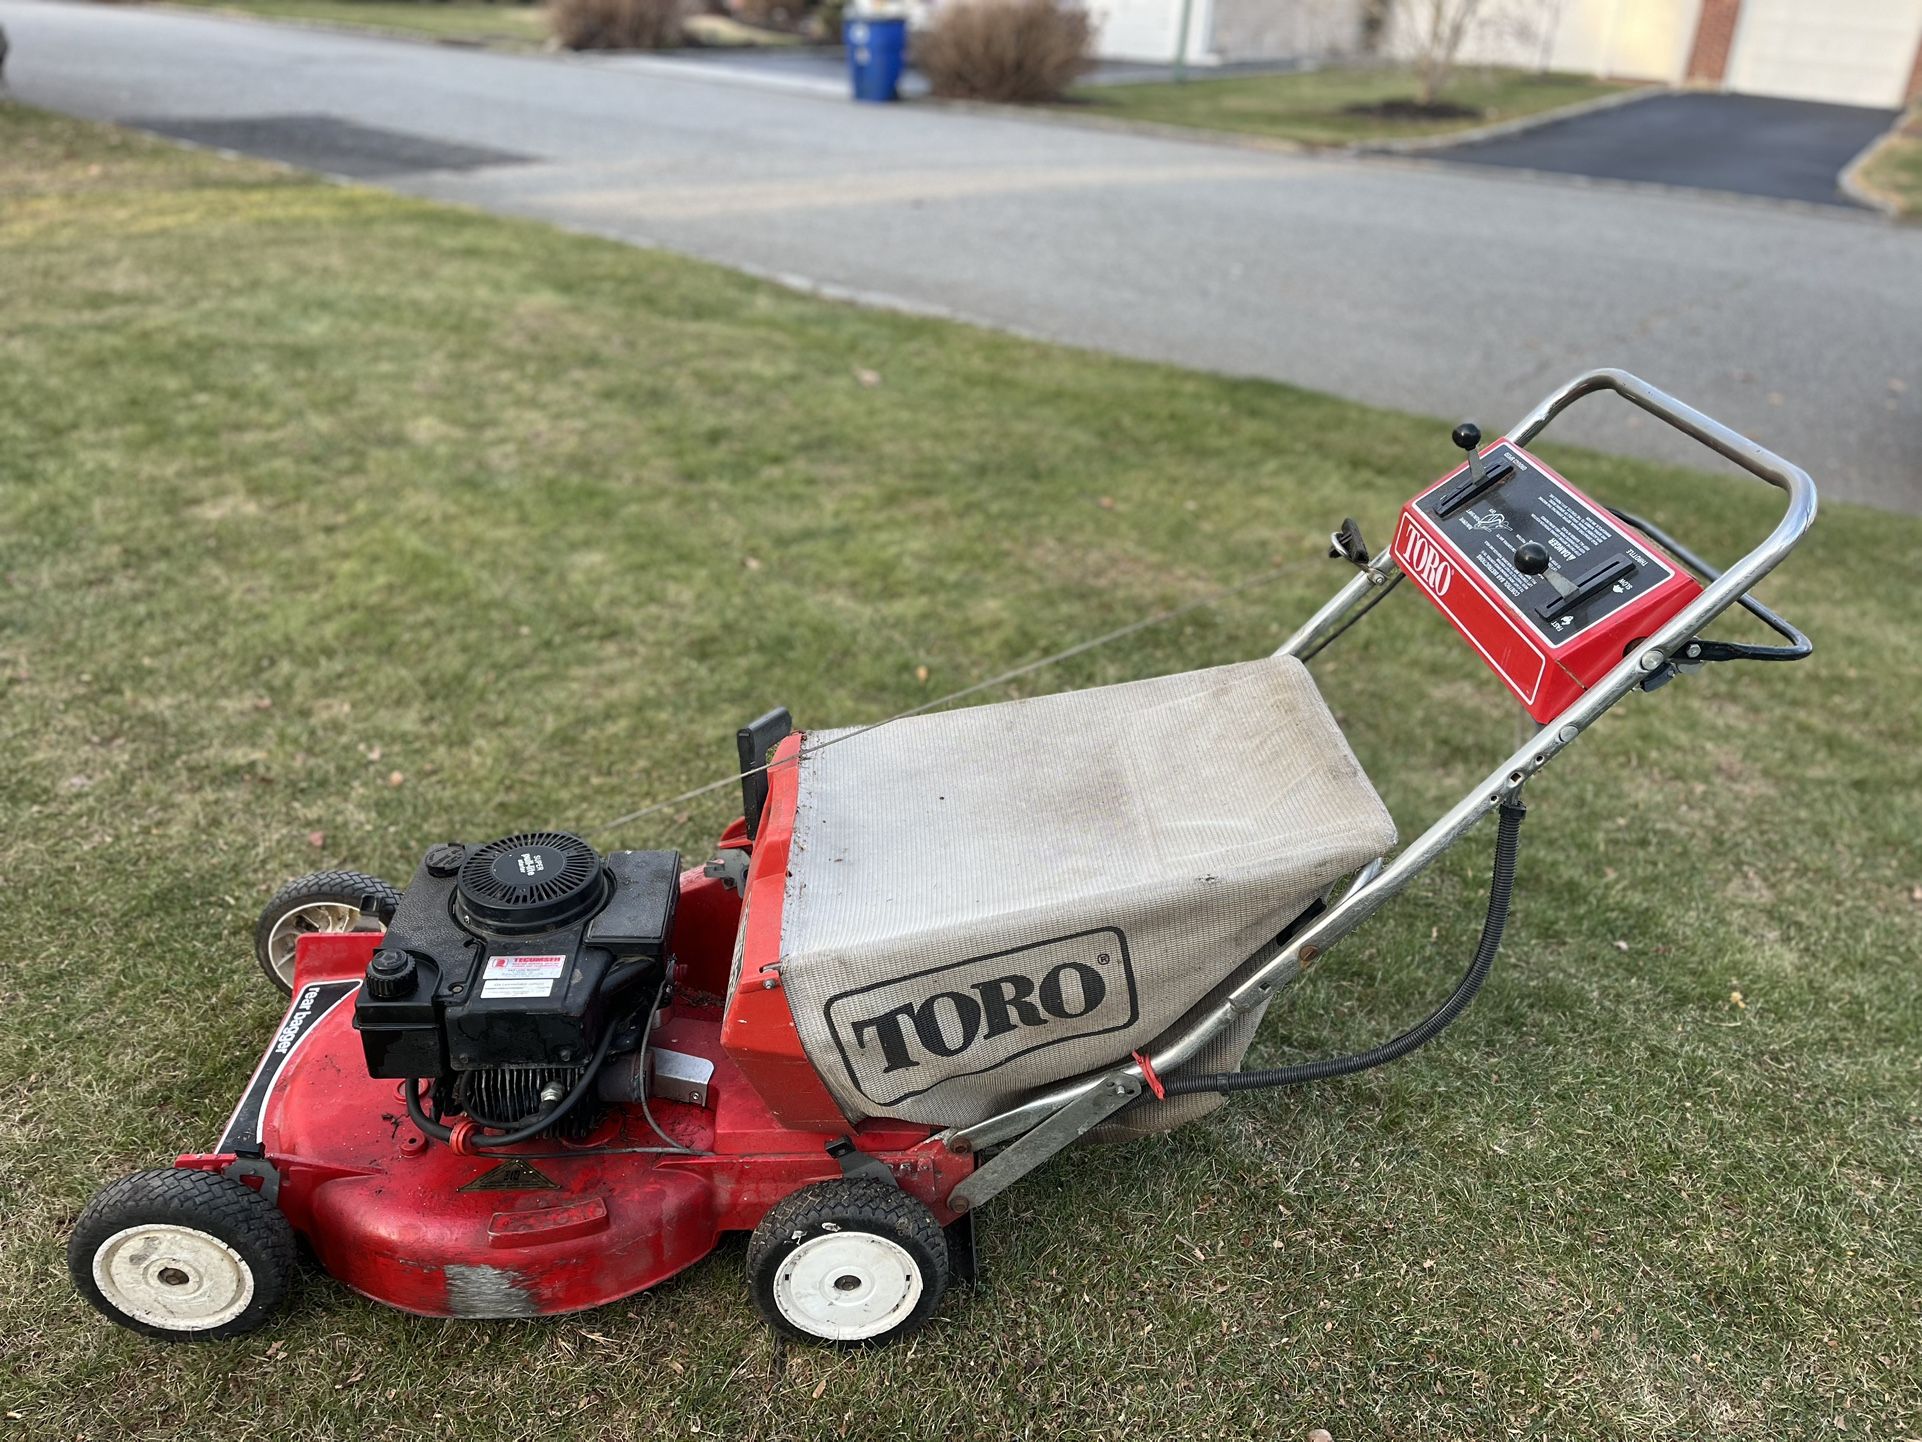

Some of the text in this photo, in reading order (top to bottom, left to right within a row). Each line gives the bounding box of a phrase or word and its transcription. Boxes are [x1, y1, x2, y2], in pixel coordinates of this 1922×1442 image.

[1546, 537, 1571, 557] DANGER
[1403, 524, 1451, 596] TORO
[1625, 548, 1649, 566] THROTTLE
[1617, 577, 1633, 590] SLOW
[1550, 620, 1563, 631] FAST
[534, 855, 544, 871] SUPER
[275, 987, 320, 1054] rear bagger
